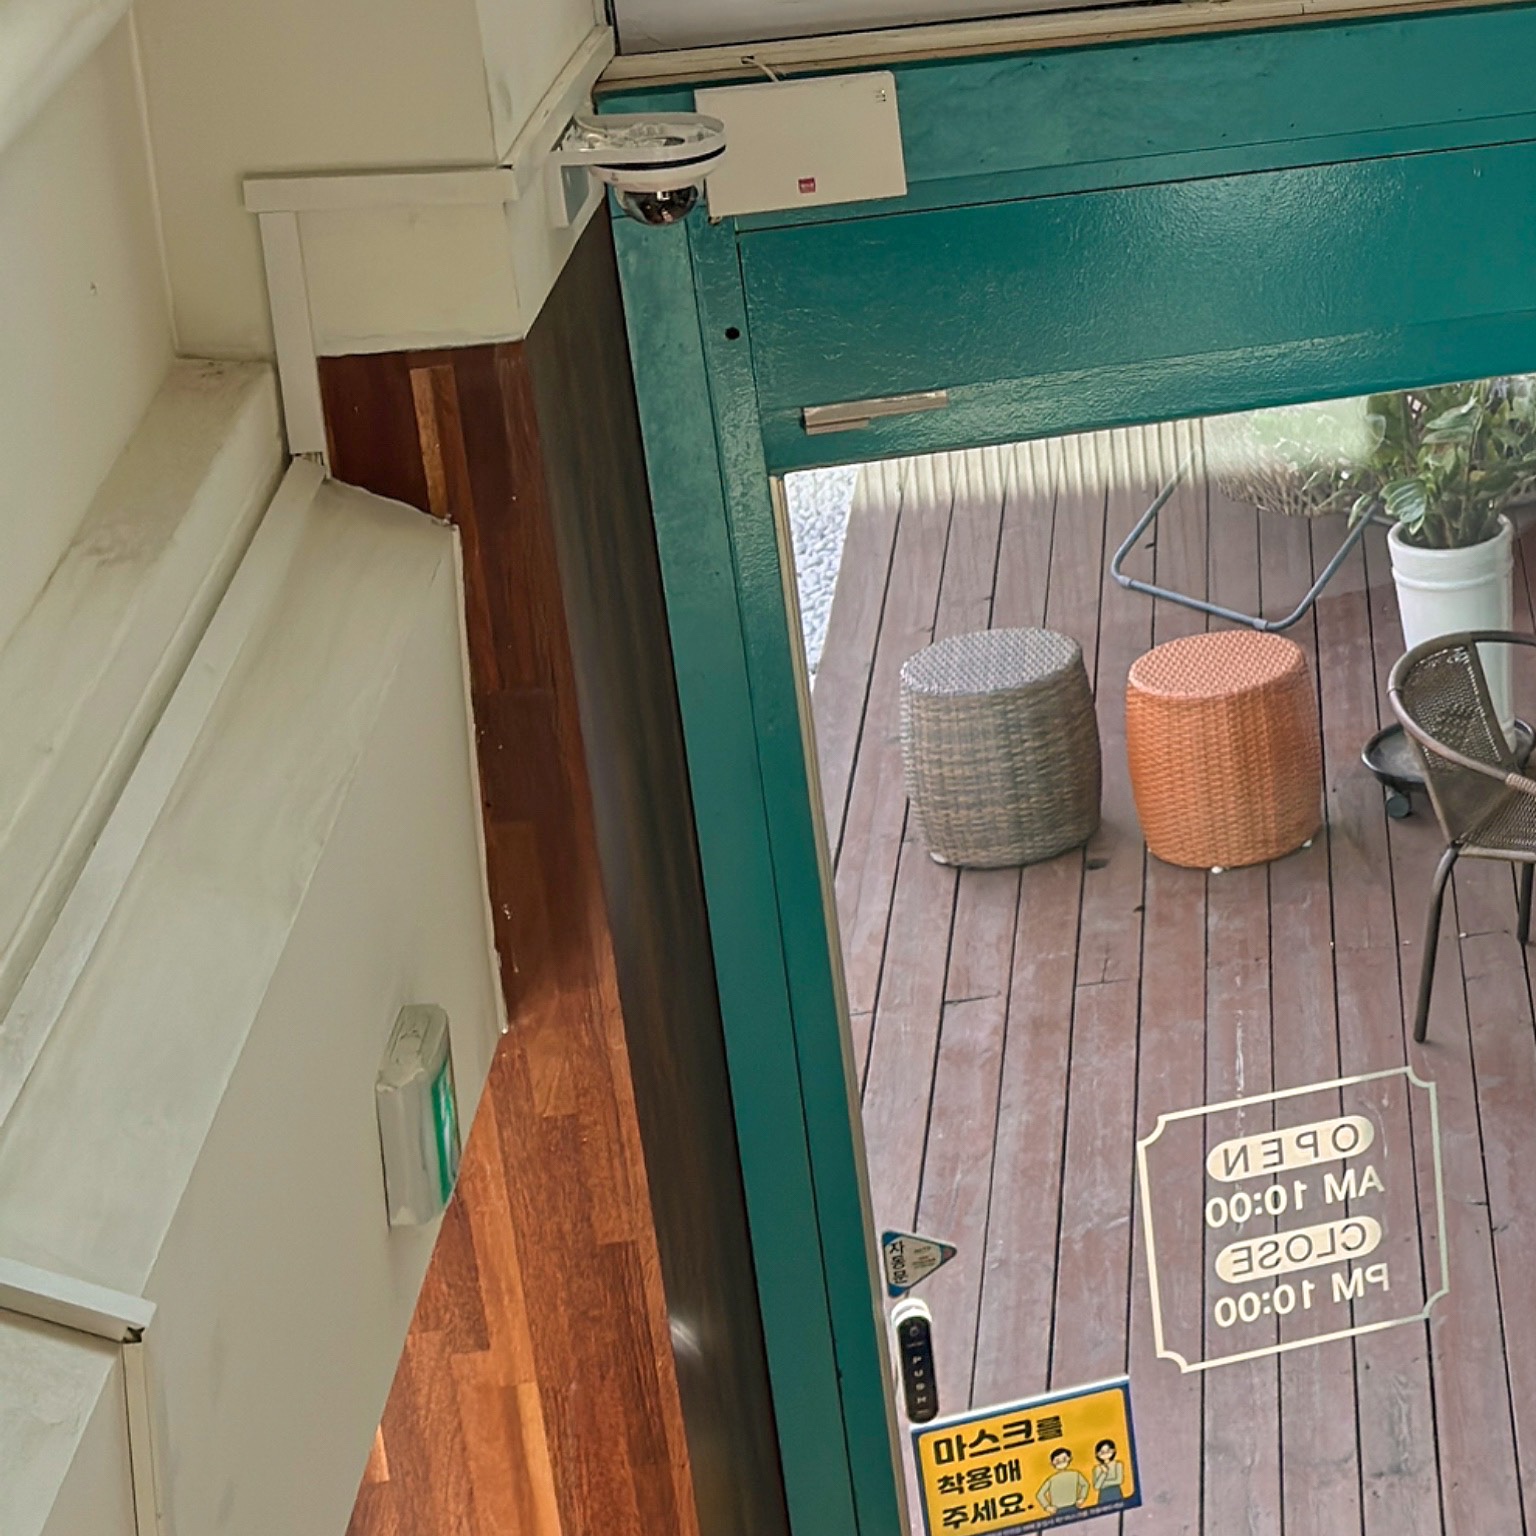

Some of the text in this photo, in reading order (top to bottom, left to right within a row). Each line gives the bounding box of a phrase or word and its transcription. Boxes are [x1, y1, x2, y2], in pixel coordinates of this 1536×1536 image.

[933, 1415, 1063, 1465] 마스크를
[937, 1459, 1022, 1495] 착용해
[942, 1492, 1034, 1529] 주세요.
